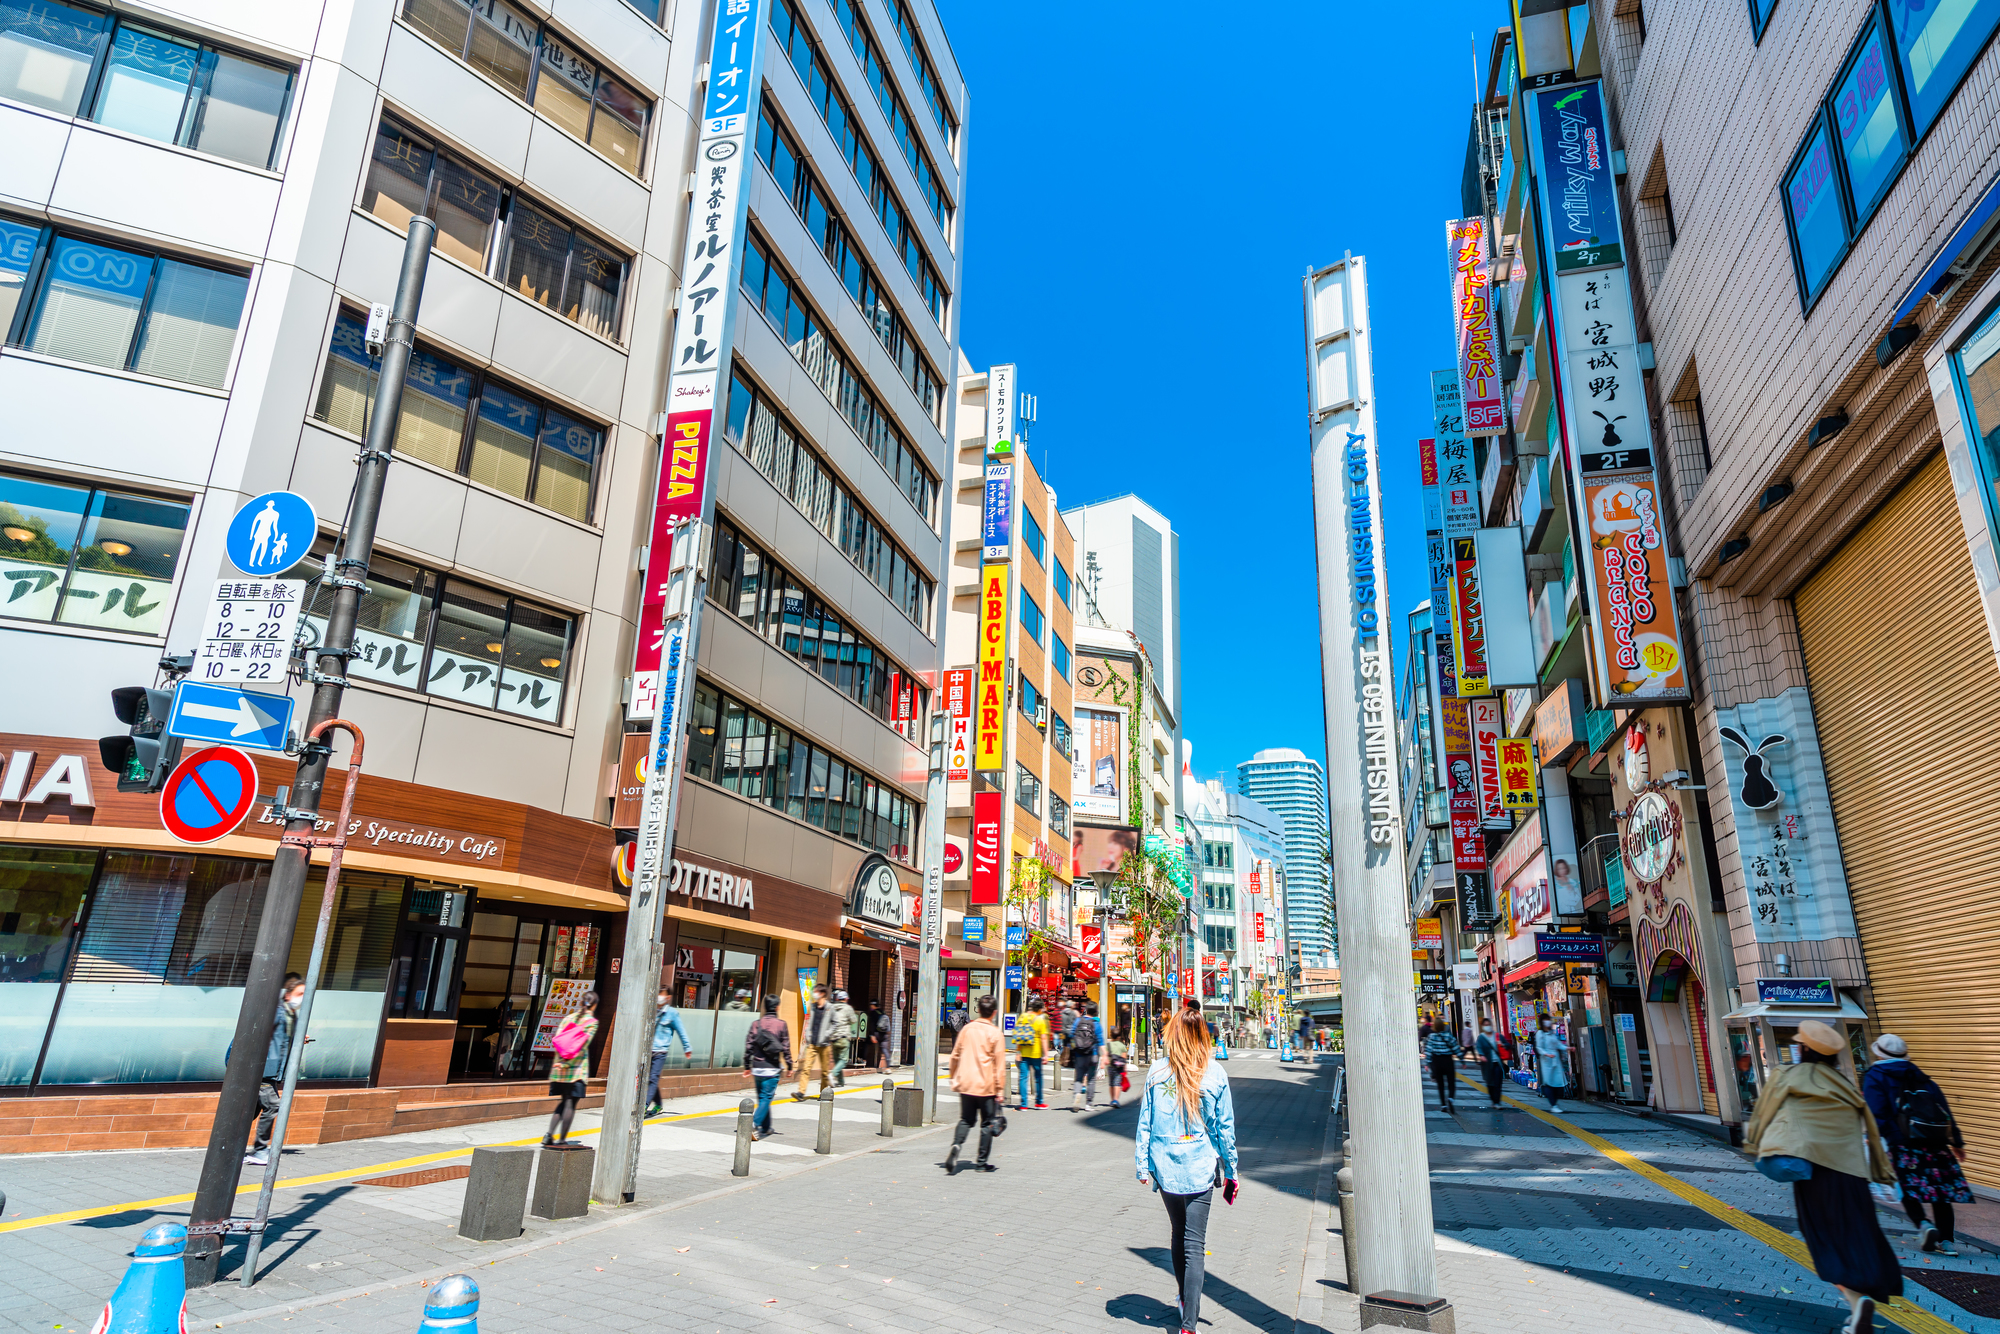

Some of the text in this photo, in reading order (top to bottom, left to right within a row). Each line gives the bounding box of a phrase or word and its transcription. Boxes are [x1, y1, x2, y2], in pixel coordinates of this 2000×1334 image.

[1535, 72, 1562, 87] 5F
[711, 117, 738, 133] 3F
[1557, 109, 1588, 165] Way
[9, 238, 129, 285] EON
[681, 166, 728, 367] 喫茶室ルノアール
[1577, 250, 1601, 266] 2F
[331, 321, 562, 436] 英話イーオン
[674, 384, 711, 398] Shakey's
[996, 373, 1006, 440] スーモカウンター
[1469, 405, 1501, 424] 5F
[666, 421, 701, 500] PIZZA
[1346, 431, 1369, 482] CITY
[1600, 451, 1630, 470] 2F
[997, 482, 1007, 516] 海外旅行
[989, 547, 1003, 557] 3F
[1350, 484, 1378, 604] SUNSHINE
[217, 583, 298, 600] 自転車を除く
[1625, 533, 1653, 622] COCO
[1356, 608, 1380, 644] TO
[981, 577, 1003, 755] ABC-MART
[1359, 646, 1383, 679] ST
[1645, 643, 1675, 671] B1
[658, 668, 678, 746] SUNSHINE
[668, 633, 683, 667] CITY
[948, 671, 965, 716] 中国語
[1465, 682, 1485, 691] 3F
[1477, 704, 1495, 722] 2F
[0, 750, 96, 808] IA
[1502, 741, 1530, 791] 麻雀
[1453, 799, 1477, 808] KFC
[364, 821, 455, 854] Speciality
[459, 836, 499, 861] Cafe
[667, 858, 755, 911] OTTERIA
[1750, 857, 1780, 924] 宮城野
[1467, 972, 1480, 981] Soft
[1764, 985, 1828, 998] Milky Way
